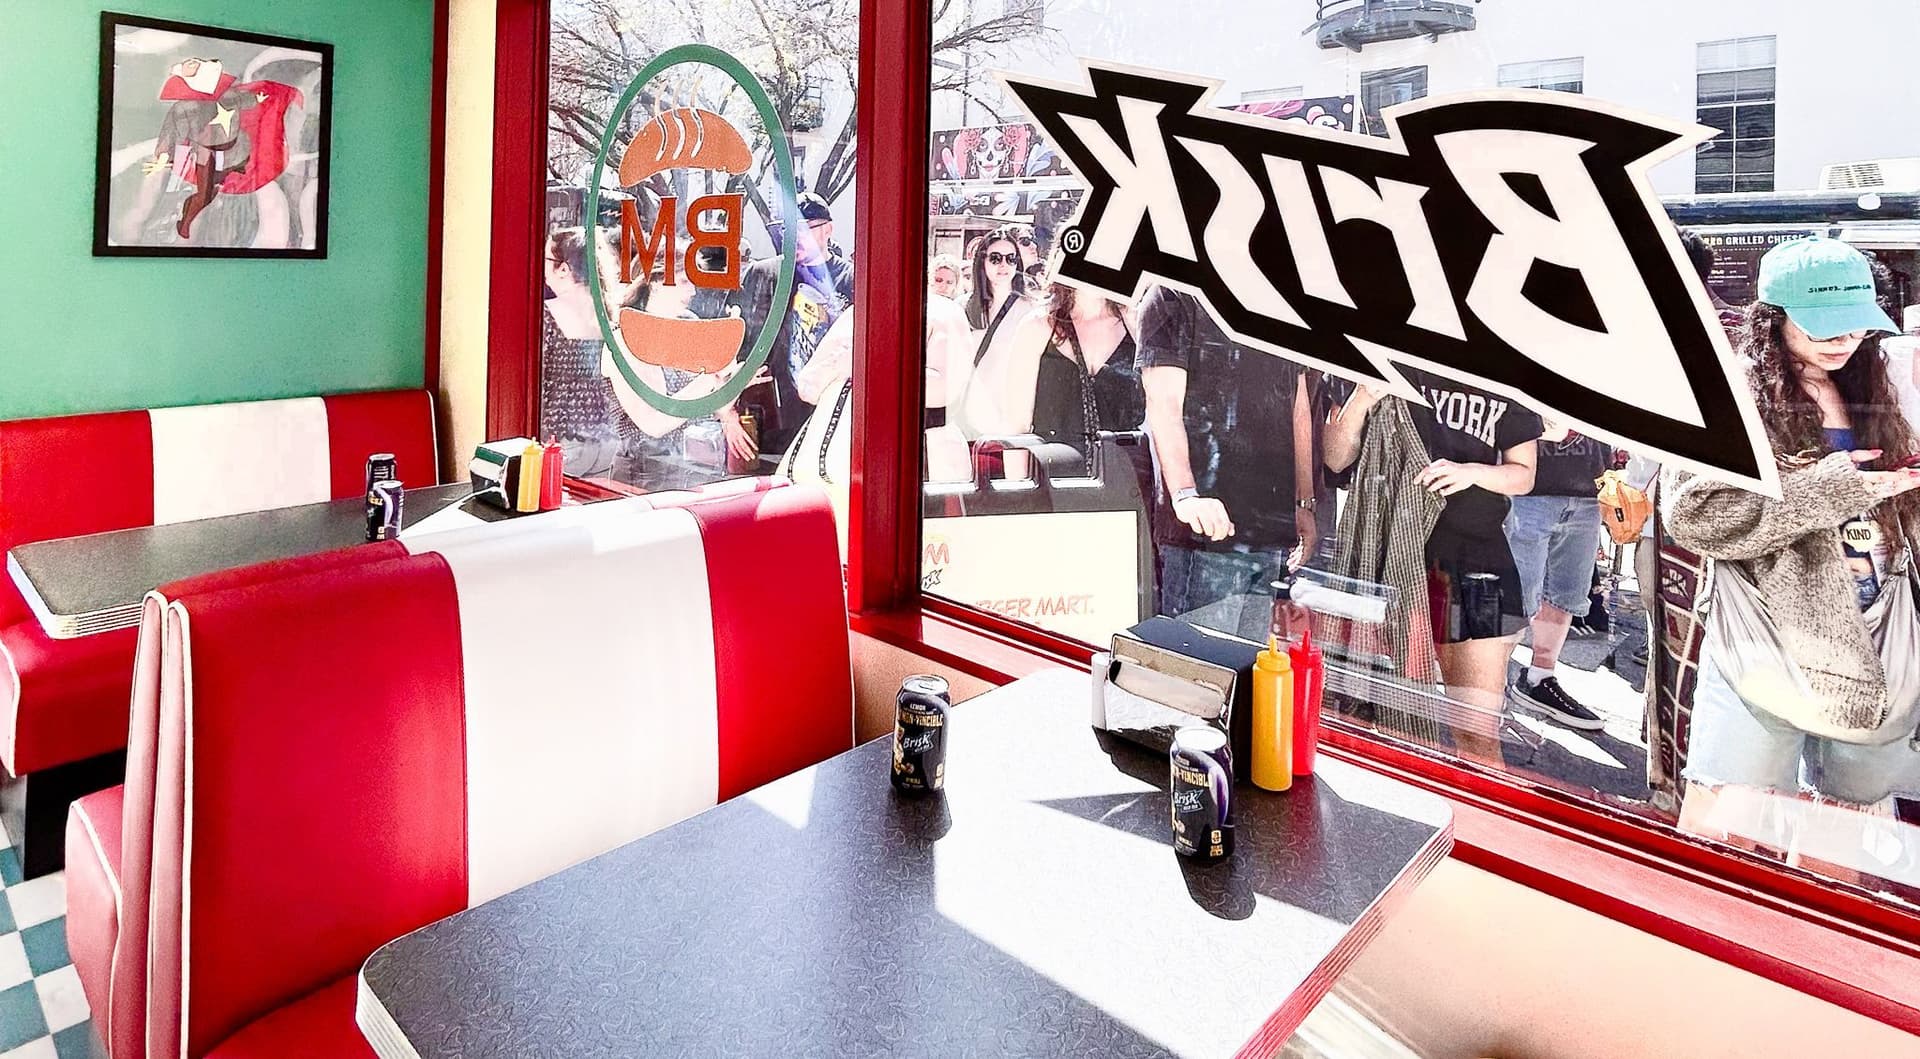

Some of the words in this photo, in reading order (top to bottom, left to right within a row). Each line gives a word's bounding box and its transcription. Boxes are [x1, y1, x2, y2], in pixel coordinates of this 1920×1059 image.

[1726, 236, 1764, 245] GRILLED
[1431, 389, 1507, 448] YORK
[1845, 528, 1871, 540] KIND
